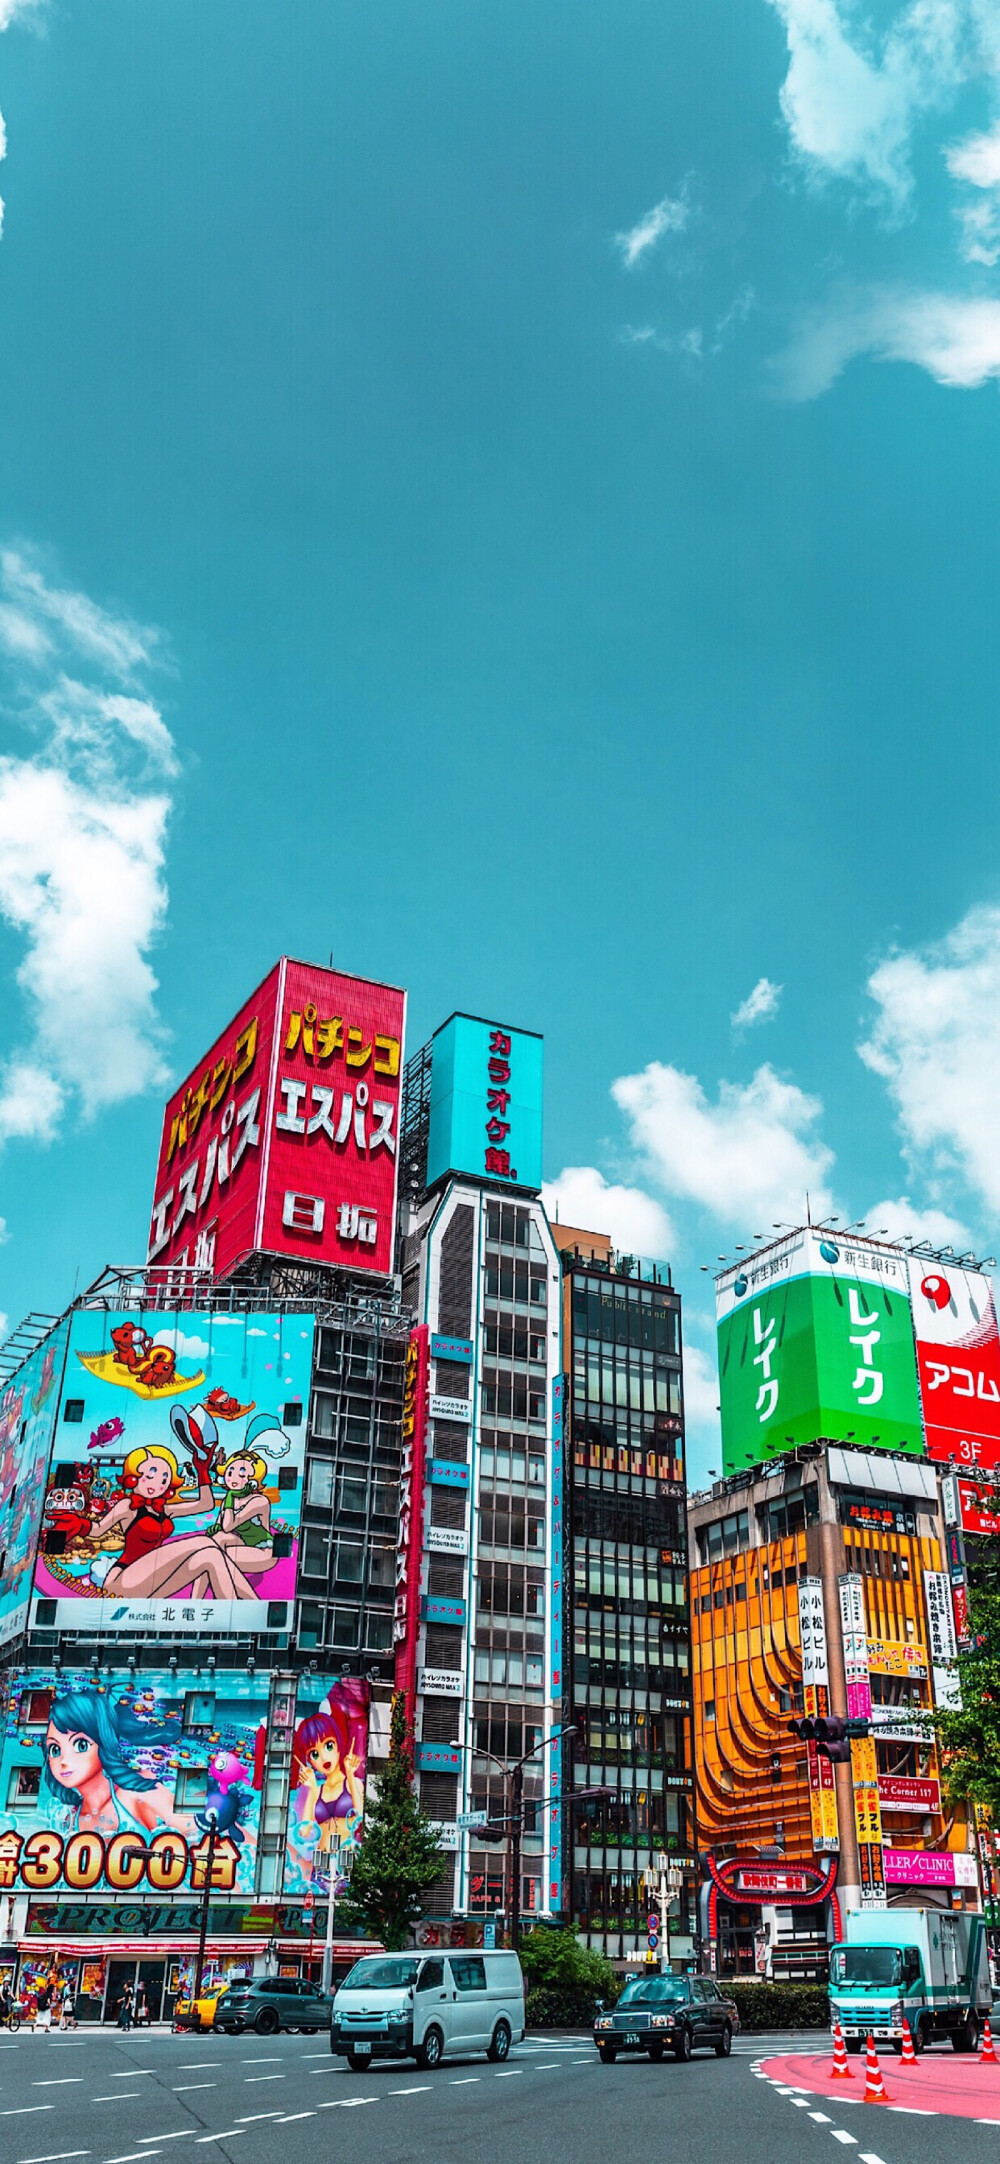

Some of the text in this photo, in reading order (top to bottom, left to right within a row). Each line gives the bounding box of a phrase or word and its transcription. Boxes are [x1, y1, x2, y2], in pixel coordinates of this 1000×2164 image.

[284, 1002, 400, 1077] パチンコ
[165, 1016, 258, 1163] パチンコ
[276, 1077, 396, 1154] エスパス
[147, 1086, 261, 1264] エスパス
[750, 1255, 790, 1285] 新生銀行
[844, 1250, 897, 1277] 新生銀行
[753, 1307, 779, 1423] レイク
[848, 1287, 884, 1405] レイク
[925, 1360, 1000, 1404] アコム
[402, 1338, 417, 1437] パチンコ
[959, 1440, 982, 1460] 3F
[396, 1444, 412, 1587] エスパス
[128, 1606, 214, 1622] 株式会社 北電子
[800, 1595, 813, 1671] 小松ビル
[811, 1595, 826, 1670] 小松ビル
[890, 1786, 917, 1796] Corner
[57, 1906, 248, 1929] PROJECT
